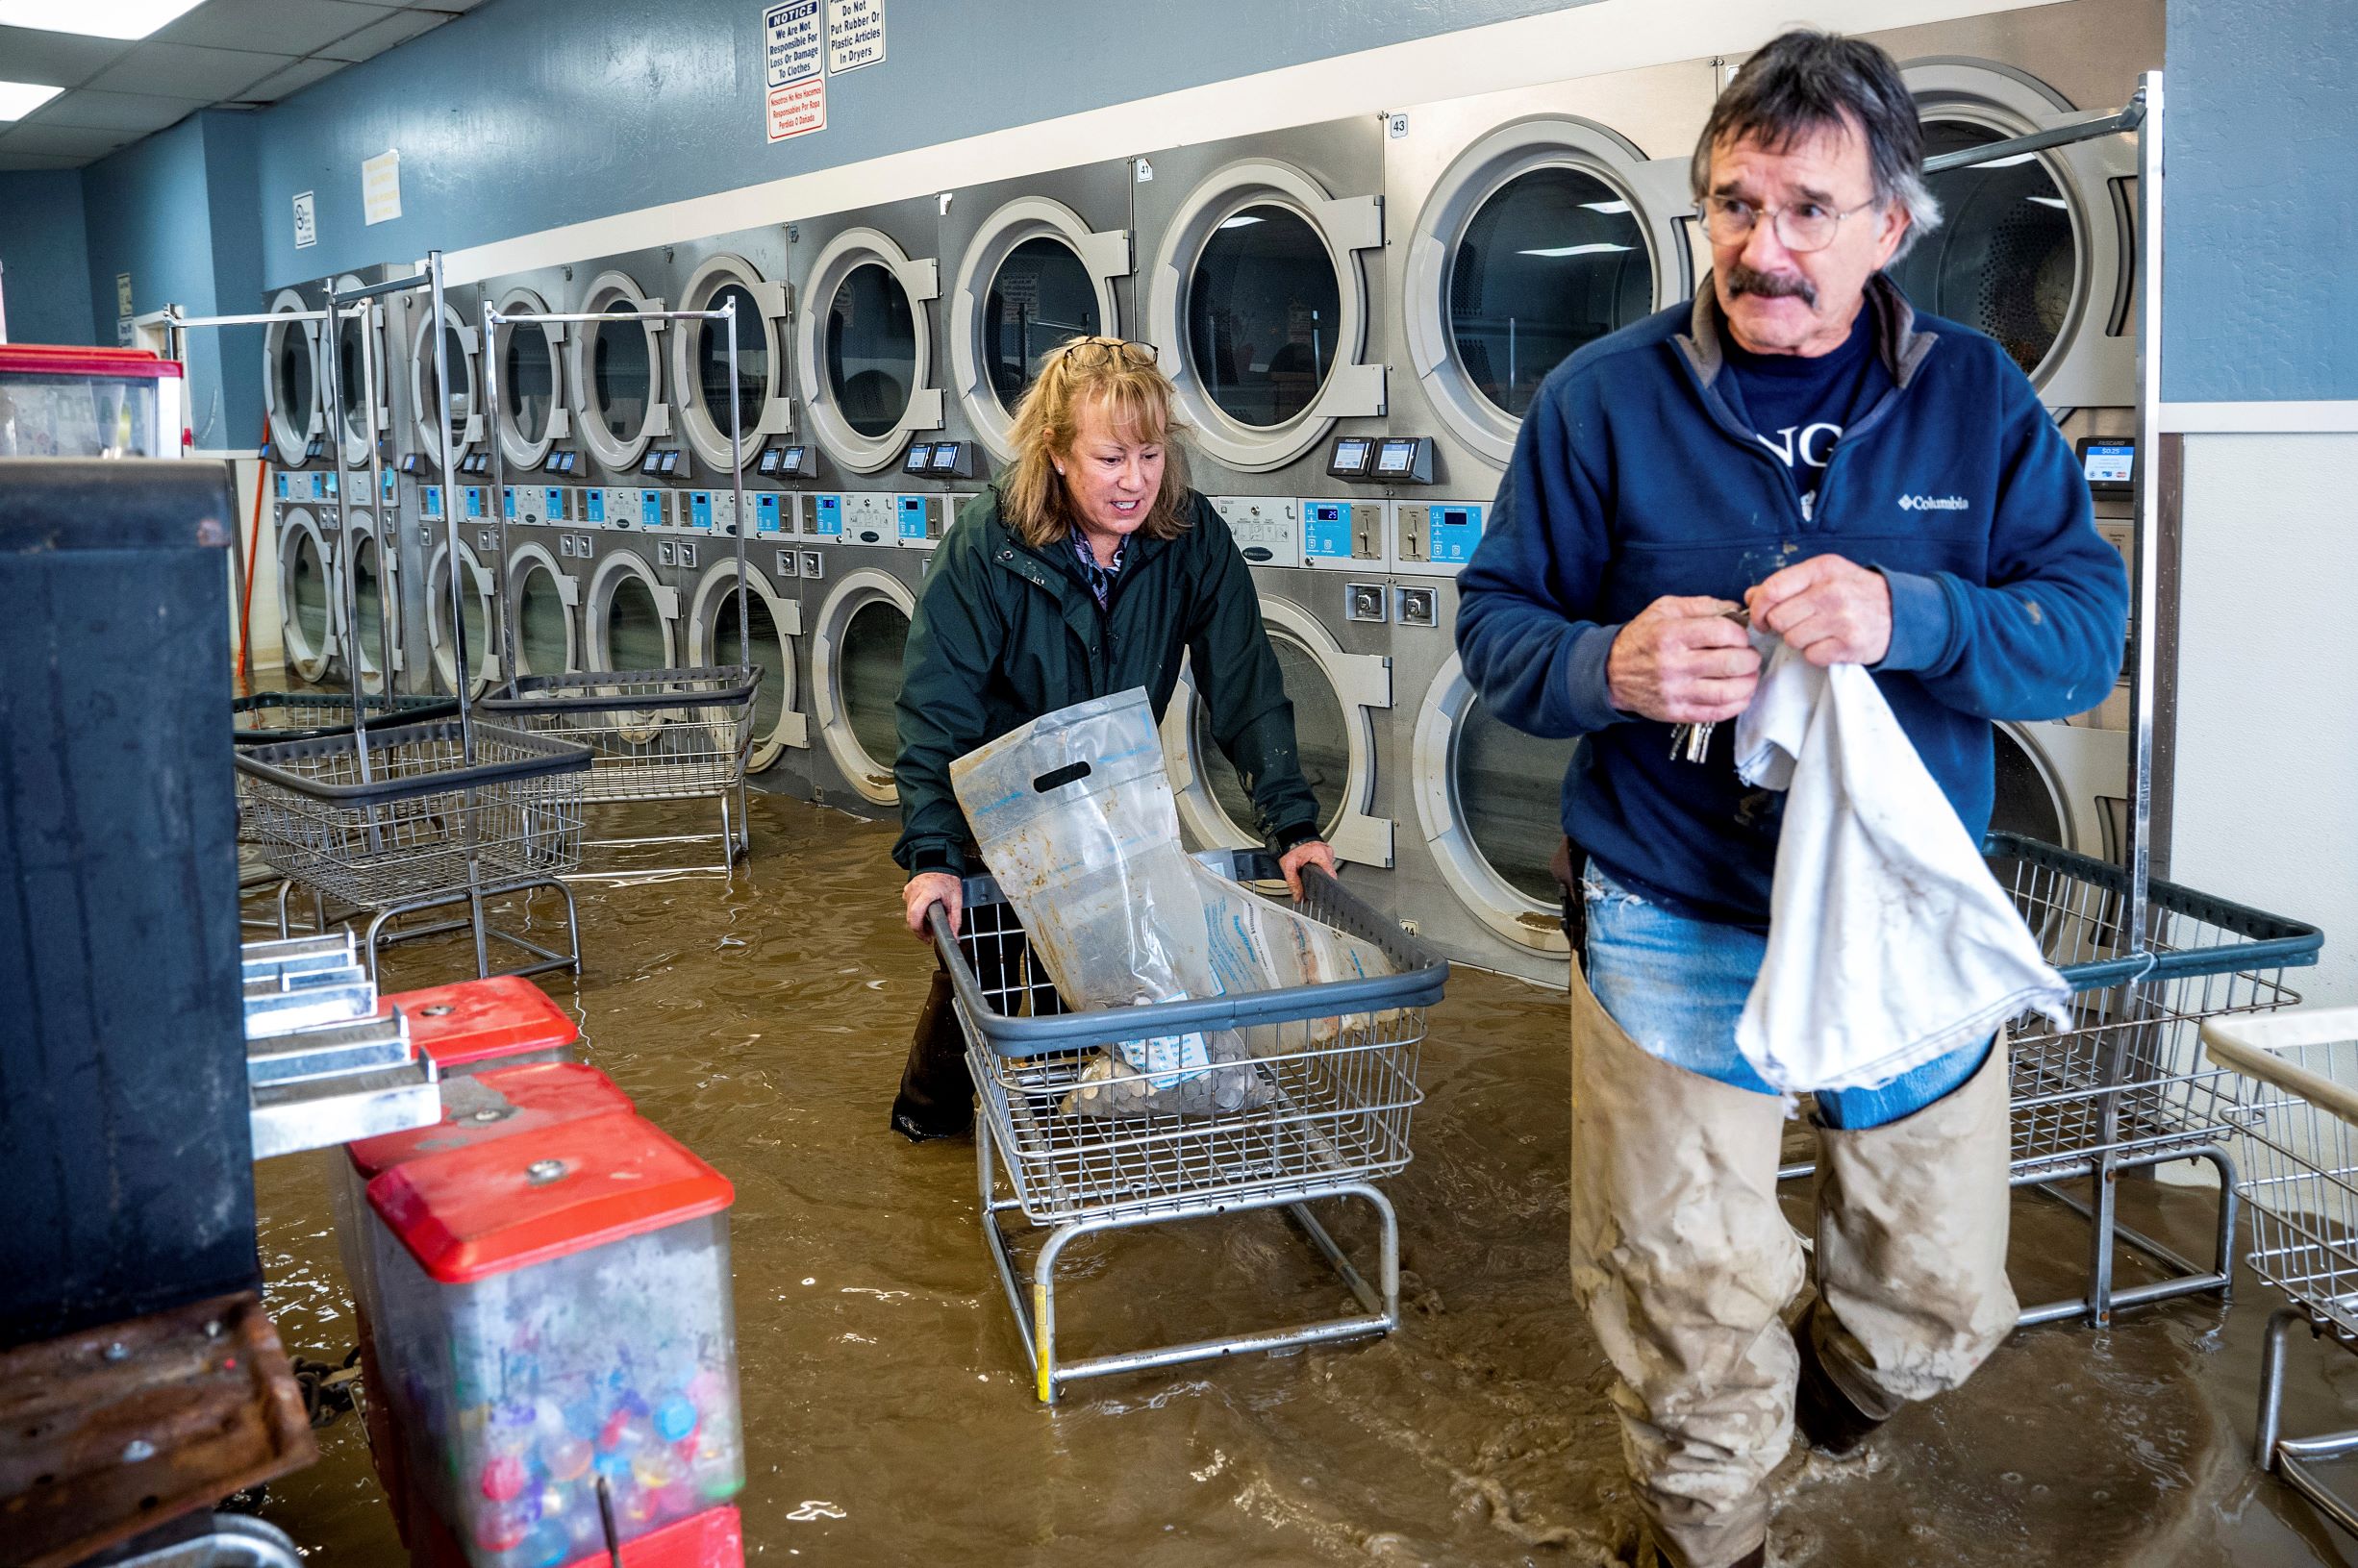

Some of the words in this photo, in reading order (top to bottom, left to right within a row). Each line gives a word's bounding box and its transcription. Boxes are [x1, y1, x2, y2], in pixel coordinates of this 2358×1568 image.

[773, 4, 814, 26] NOTICE
[841, 5, 852, 17] Do
[853, 1, 866, 13] Not
[775, 29, 786, 40] We
[787, 26, 798, 37] Are
[799, 21, 811, 33] Not
[830, 23, 842, 36] Put
[844, 15, 869, 32] Rubber
[871, 11, 880, 23] Or
[769, 37, 806, 56] Responsible
[808, 33, 818, 43] For
[831, 36, 853, 51] Plastic
[855, 28, 881, 44] Articles
[770, 58, 783, 68] Loss
[785, 54, 792, 64] Or
[793, 46, 818, 62] Damage
[840, 53, 847, 64] In
[848, 46, 872, 62] Dryers
[779, 68, 787, 79] To
[787, 62, 811, 76] Clothes
[772, 105, 801, 118] Responsables
[810, 100, 820, 111] Ropa
[794, 116, 798, 126] O
[1393, 120, 1405, 132] 43
[1141, 164, 1149, 175] 41
[2101, 446, 2120, 455] $0.25
[1913, 494, 1969, 511] Columbia
[1328, 510, 1338, 519] 25
